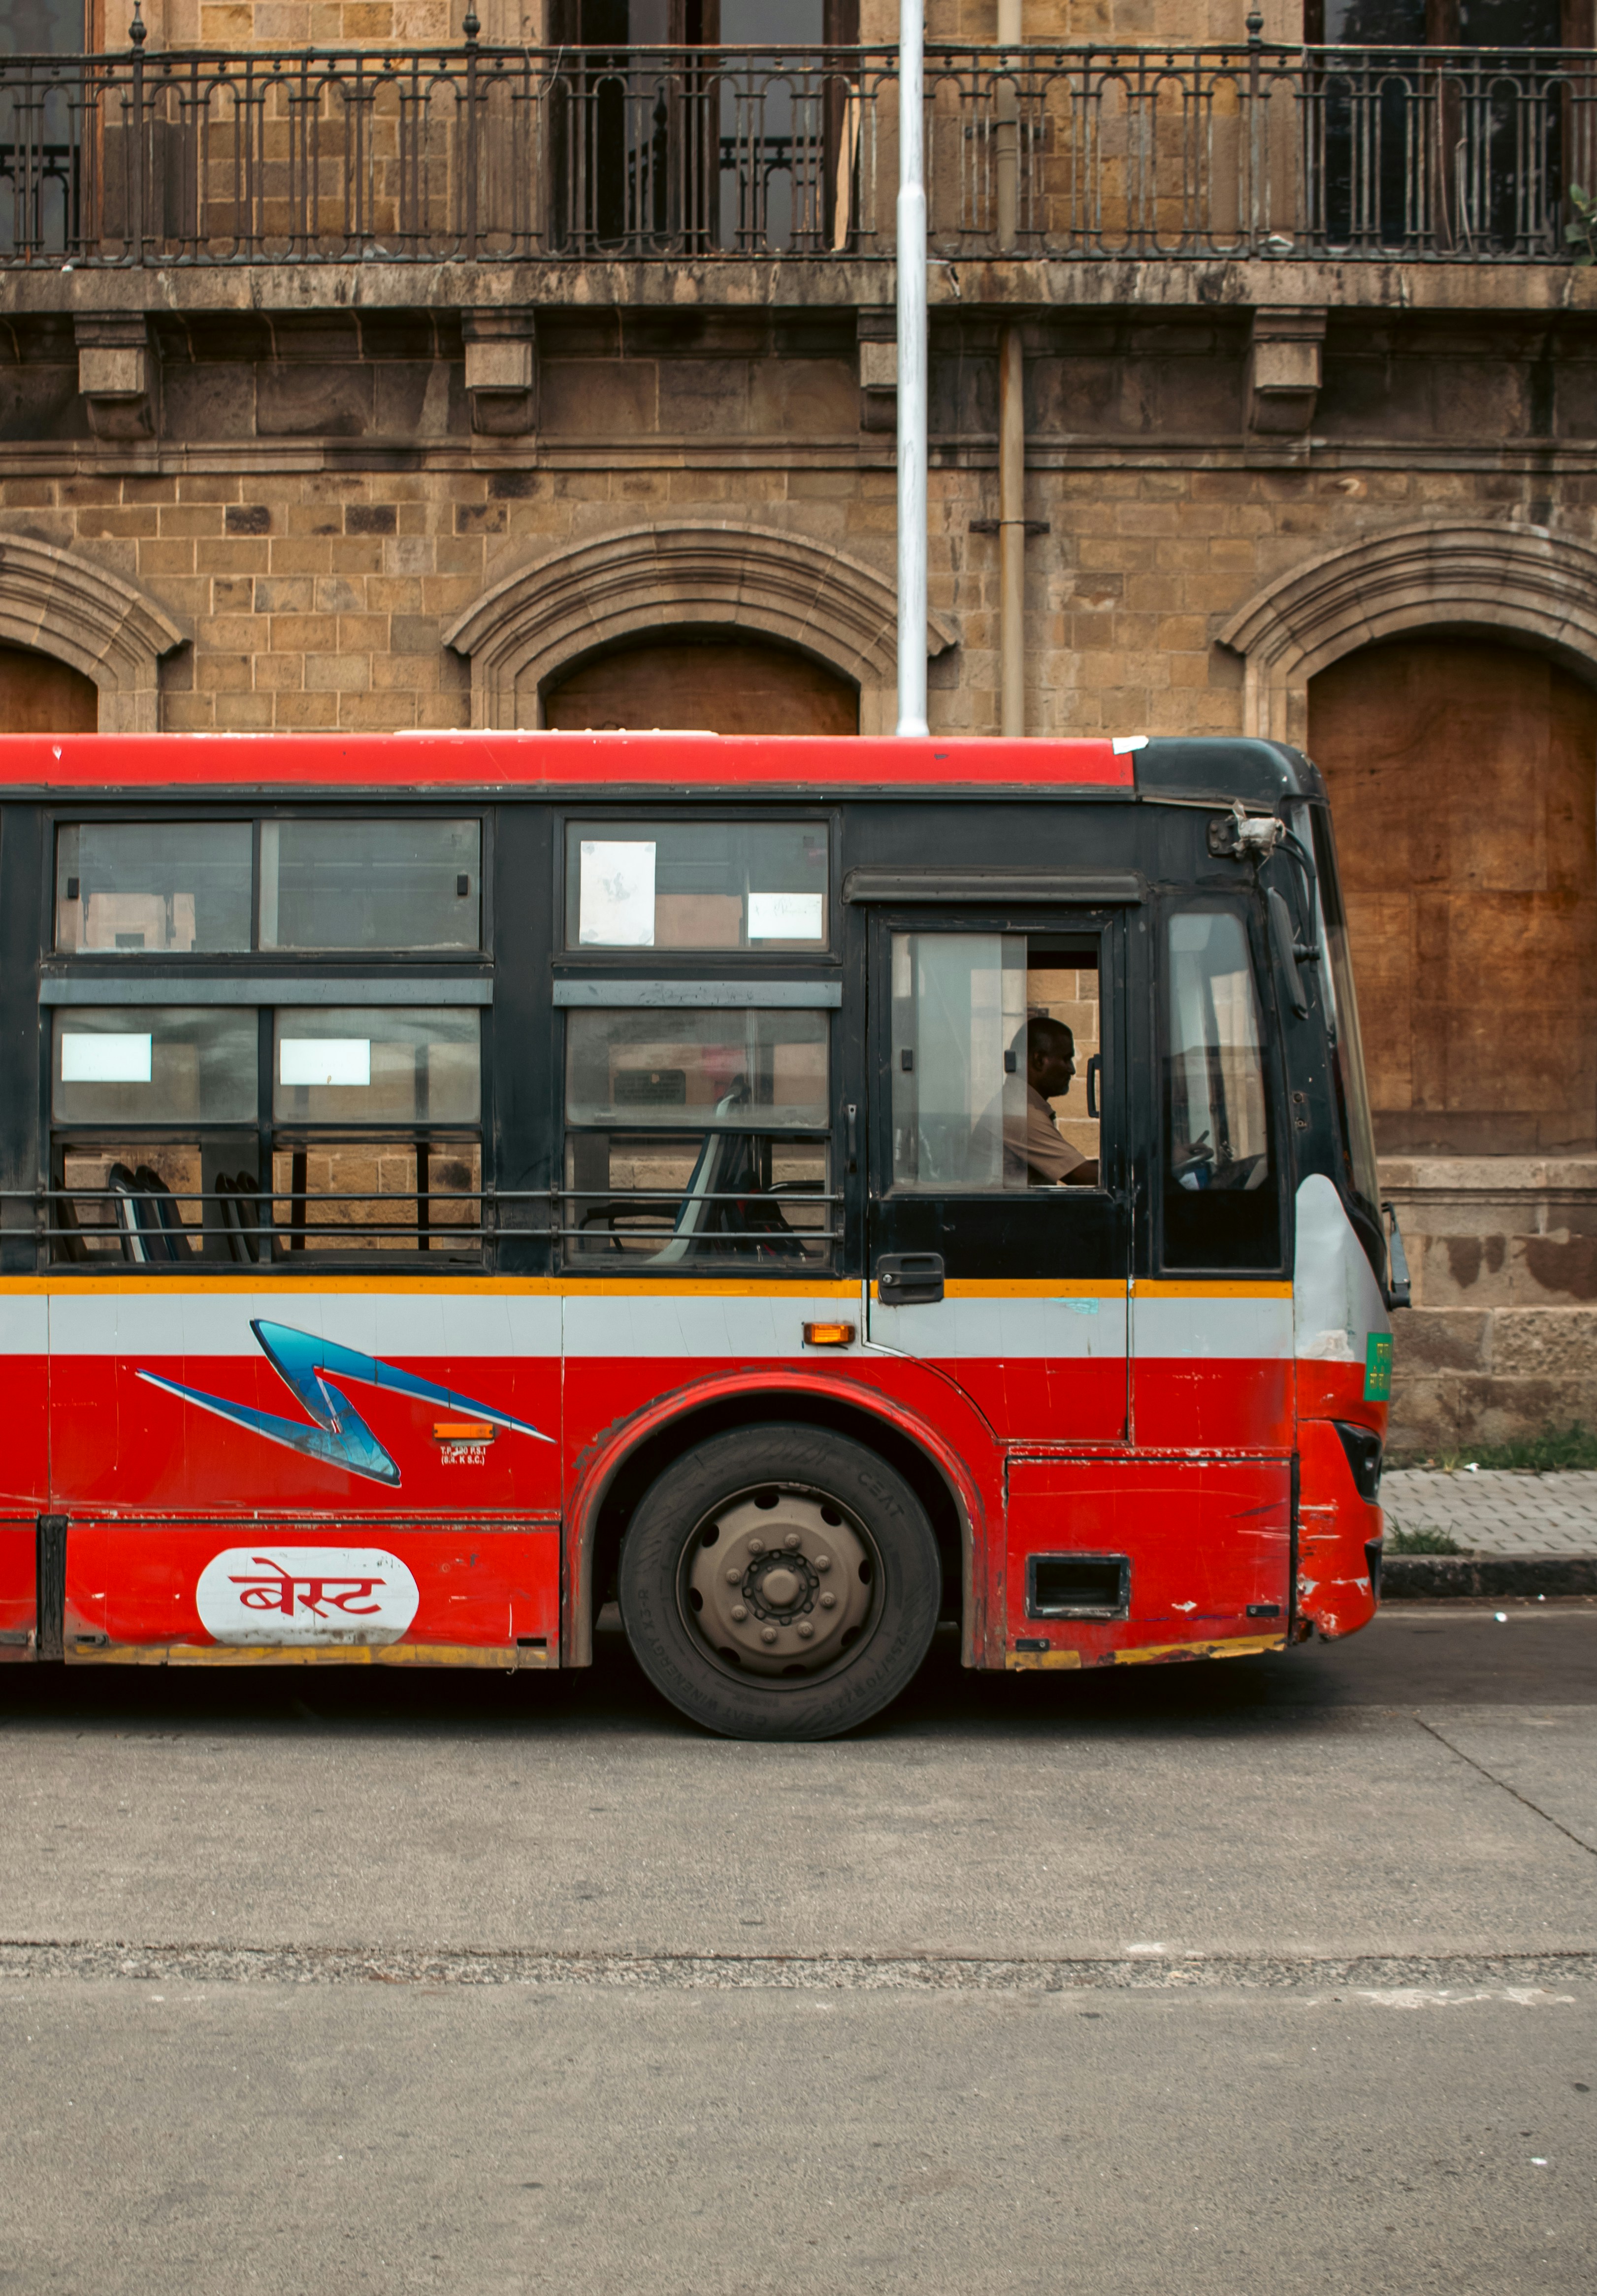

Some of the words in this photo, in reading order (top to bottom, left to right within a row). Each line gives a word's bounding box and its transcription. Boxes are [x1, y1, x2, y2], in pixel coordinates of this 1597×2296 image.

[857, 1470, 905, 1519] CEAT
[228, 1556, 387, 1619] बेस्ट
[638, 1589, 655, 1632] X3-R
[648, 1634, 720, 1713] WINENERGY
